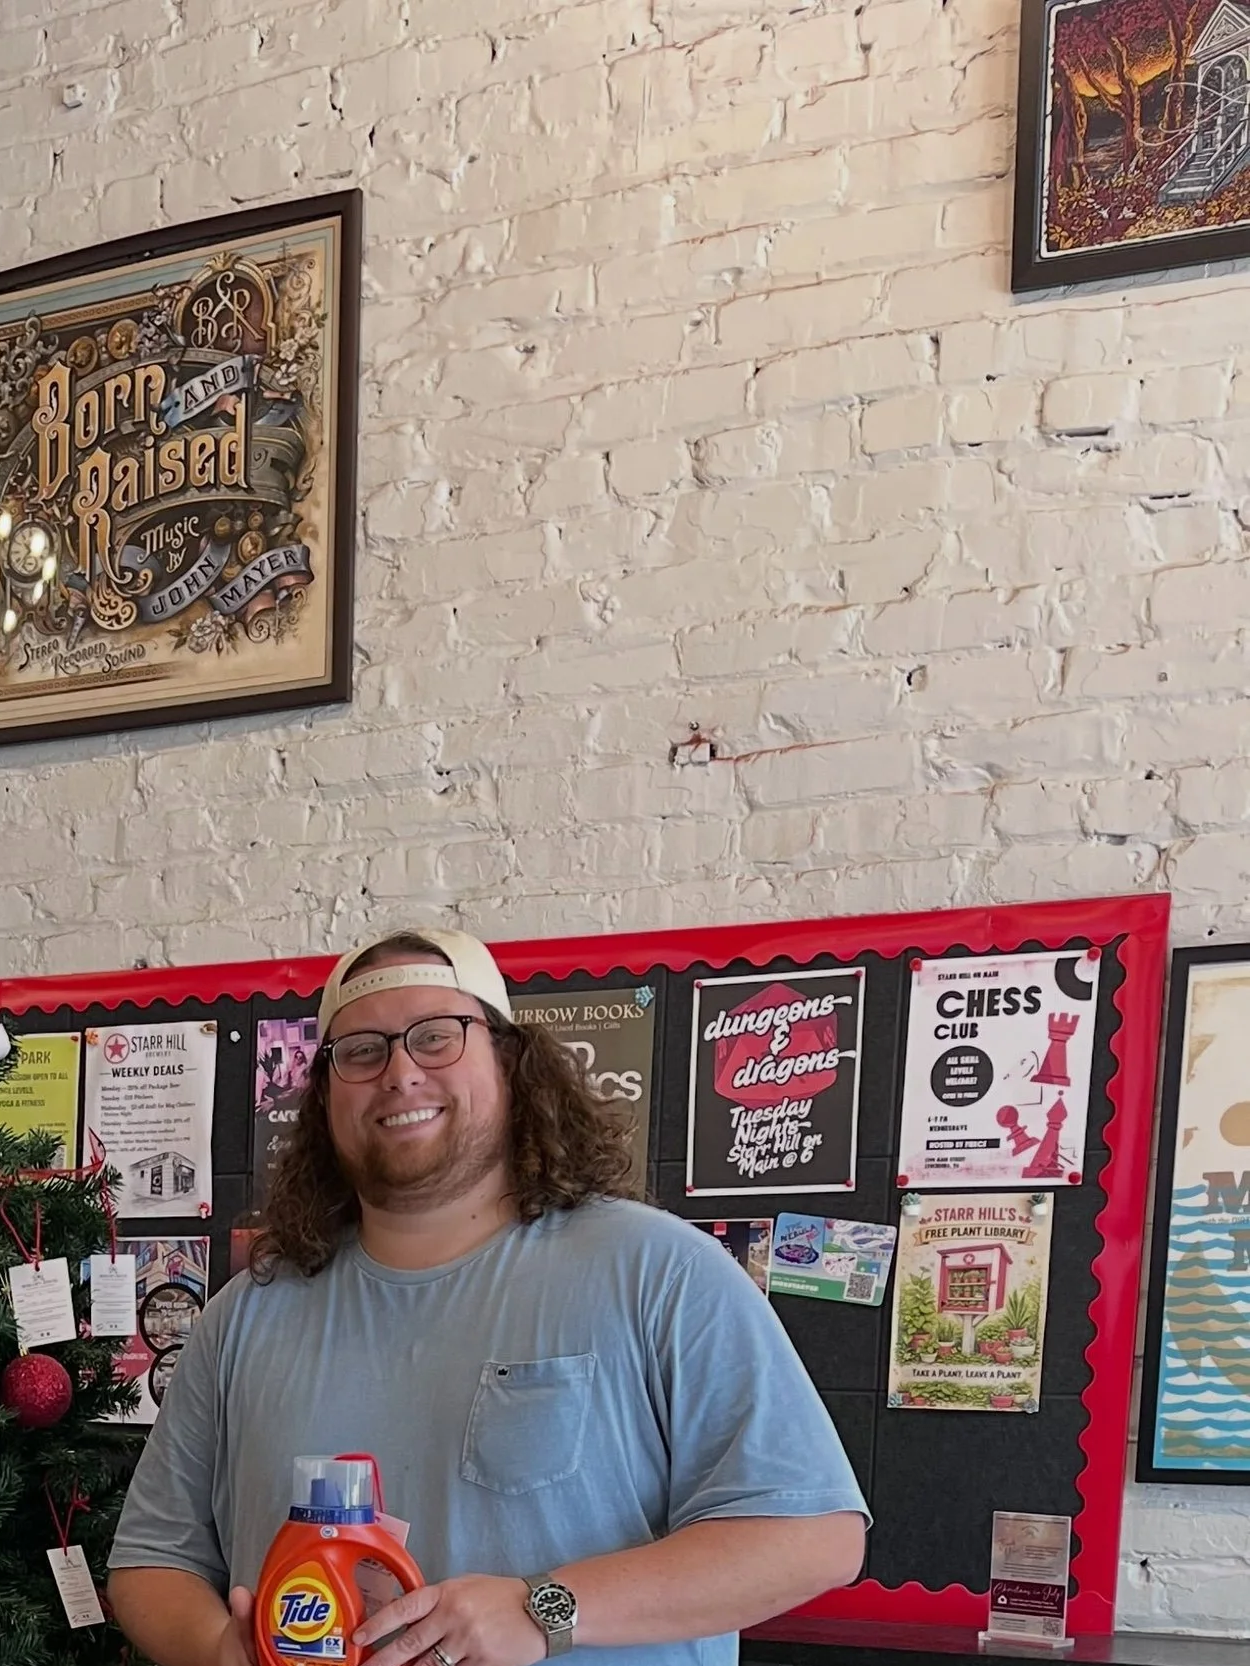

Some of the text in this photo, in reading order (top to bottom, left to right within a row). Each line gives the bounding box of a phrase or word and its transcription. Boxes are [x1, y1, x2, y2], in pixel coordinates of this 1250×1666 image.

[32, 359, 241, 503] Born AND
[74, 394, 247, 590] Raised
[152, 549, 300, 617] JOHN MAYER
[512, 1003, 644, 1025] URROW BOOKS
[936, 985, 1042, 1019] CHESS
[704, 994, 853, 1041] dungeons
[934, 1022, 979, 1040] CLUB
[131, 1033, 187, 1053] STARR HILL
[21, 1051, 51, 1065] PARK
[111, 1064, 184, 1078] WEEKLY DEALS
[732, 1049, 856, 1088] dragons
[0, 1099, 14, 1108] YOGA
[22, 1099, 45, 1107] FITNESS
[730, 1096, 813, 1129] Tuesday
[734, 1117, 812, 1146] Nights
[727, 1133, 822, 1162] Starr Hill on
[737, 1156, 780, 1179] Main
[782, 1151, 798, 1168] @
[934, 1207, 1017, 1222] STARR HILL'S
[925, 1227, 1026, 1239] FREE PLANT LIBRARY
[279, 1593, 331, 1628] Tide
[325, 1637, 340, 1647] 6X
